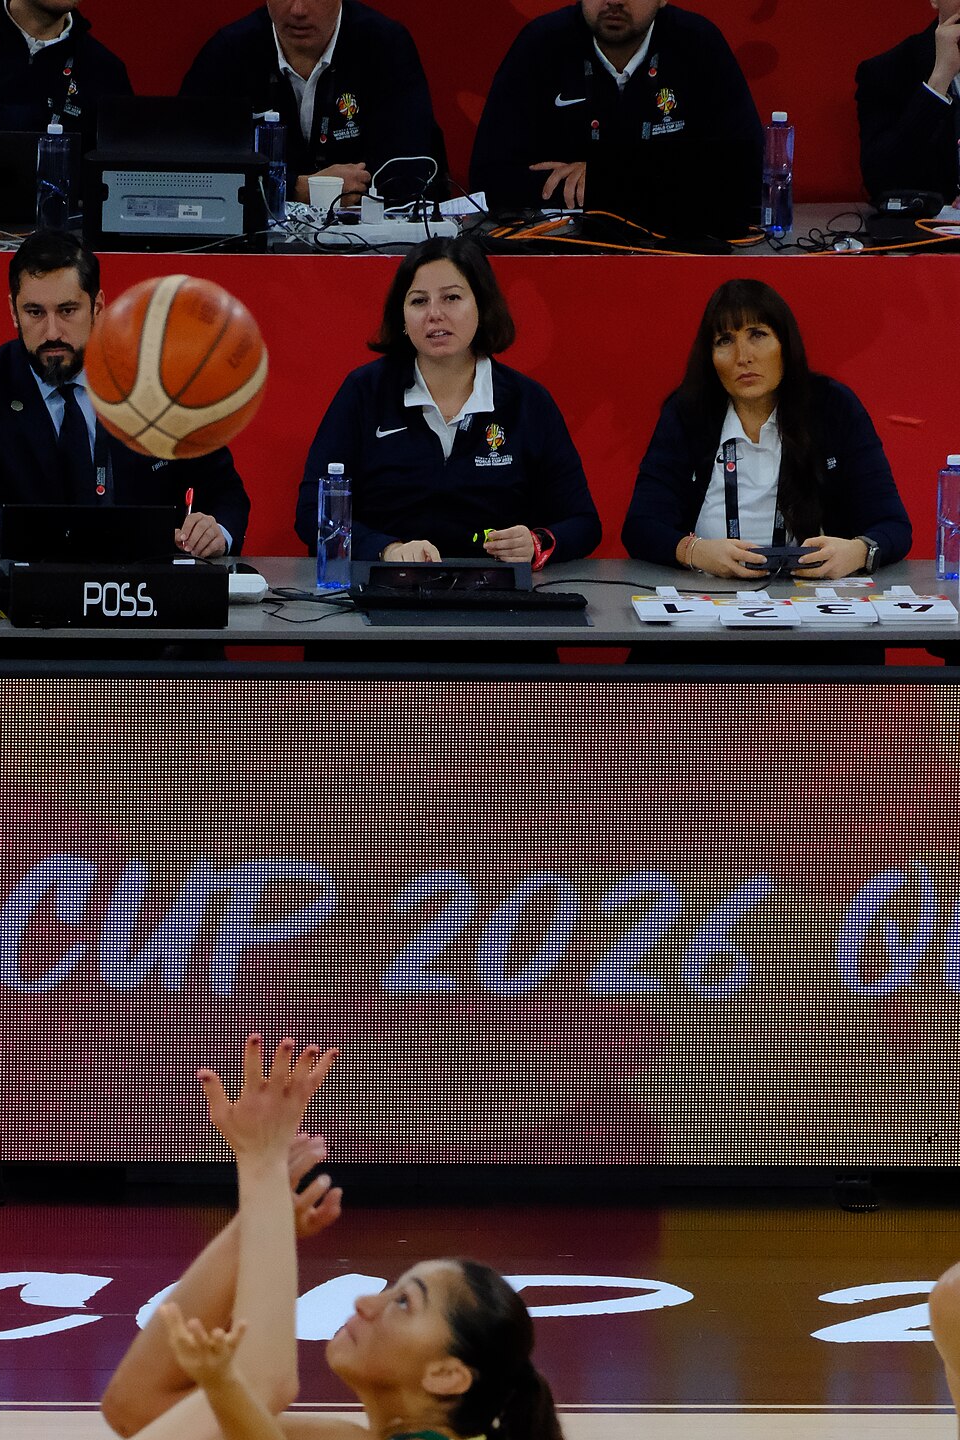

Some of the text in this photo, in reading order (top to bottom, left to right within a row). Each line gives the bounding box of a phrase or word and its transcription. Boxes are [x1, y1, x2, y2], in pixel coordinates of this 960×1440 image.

[83, 582, 158, 617] POSS.
[381, 868, 775, 1000] 2026
[836, 858, 960, 997] Q
